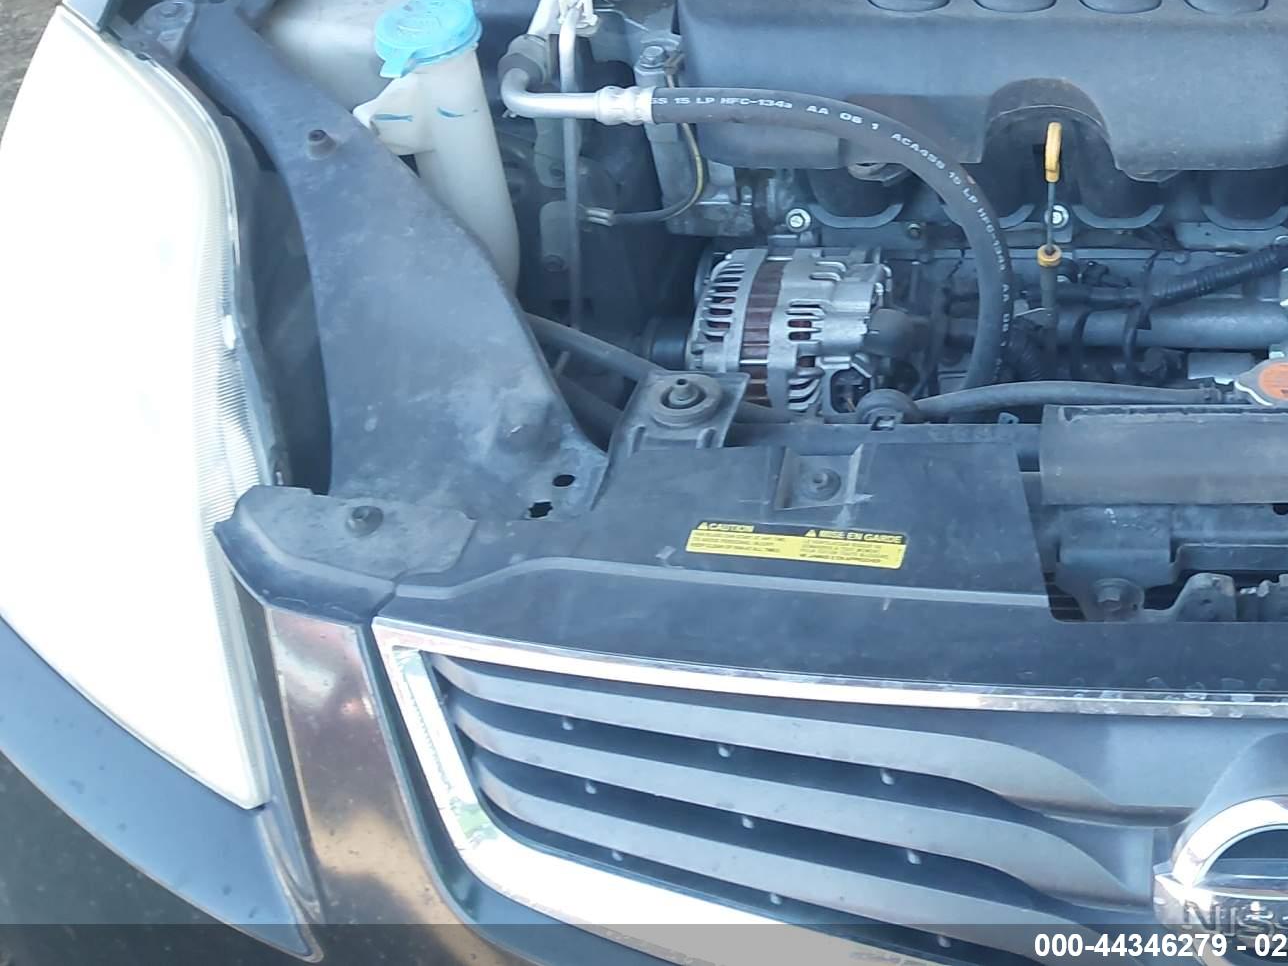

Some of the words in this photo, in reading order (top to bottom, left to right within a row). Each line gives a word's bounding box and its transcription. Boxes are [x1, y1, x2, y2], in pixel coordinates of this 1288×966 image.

[696, 97, 715, 105] LP
[806, 105, 829, 115] AA
[709, 523, 755, 533] CAUTION
[863, 534, 903, 544] GARDE
